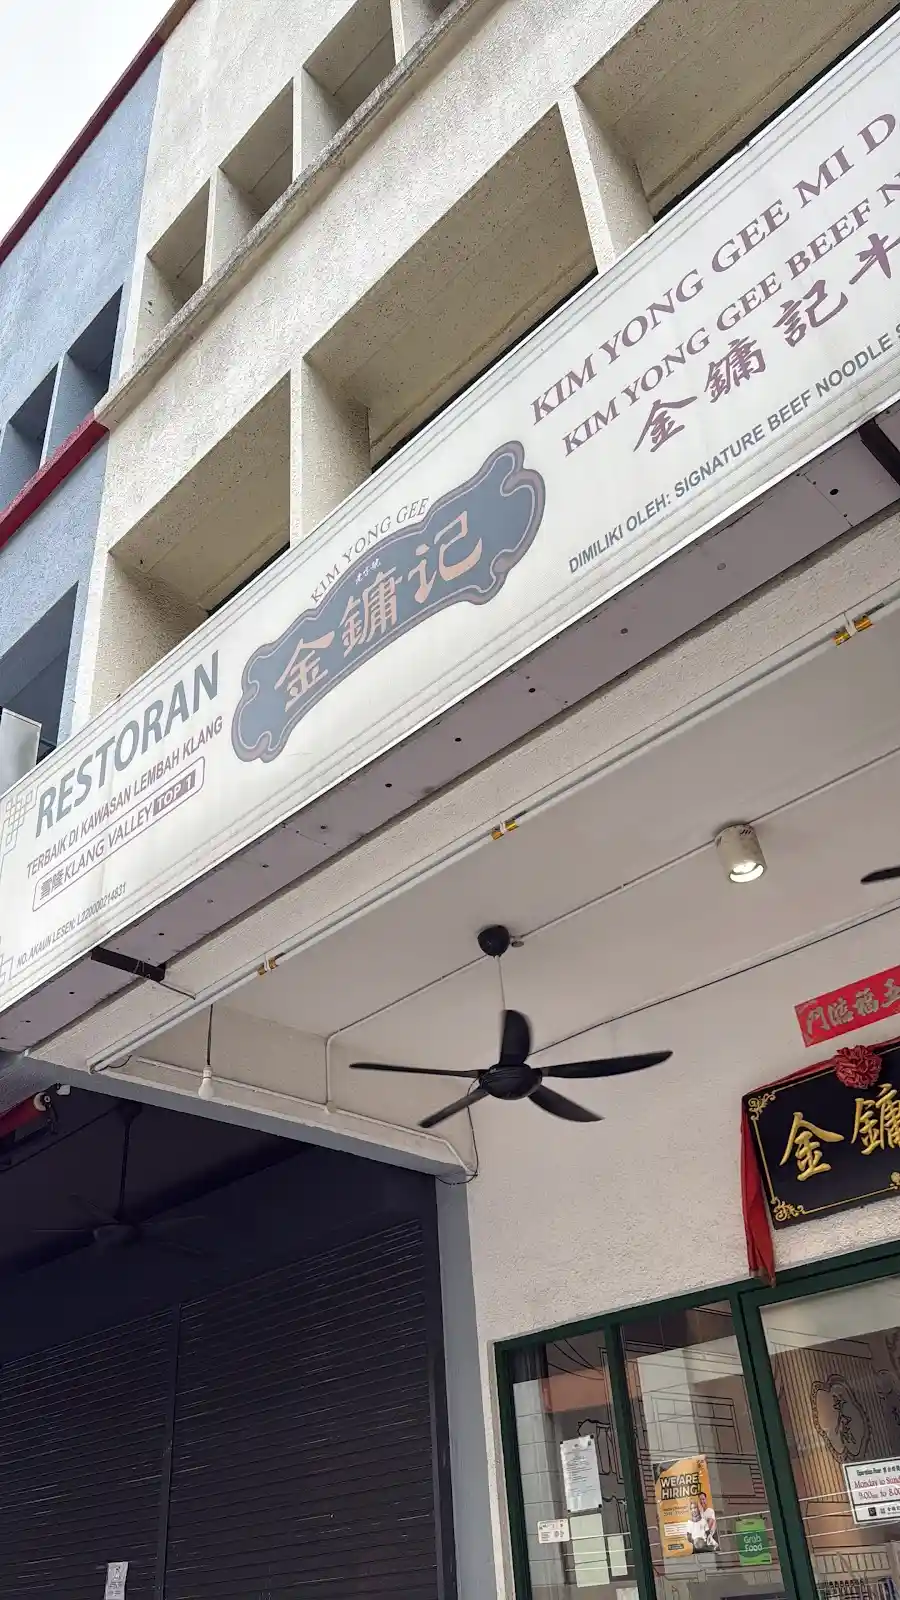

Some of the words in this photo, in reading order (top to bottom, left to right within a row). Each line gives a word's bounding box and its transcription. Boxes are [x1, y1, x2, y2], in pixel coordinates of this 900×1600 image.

[530, 354, 597, 425] KIM
[599, 268, 705, 364] YONG
[711, 199, 790, 273] GEE
[794, 145, 854, 208] MI
[561, 397, 620, 456] KIM
[621, 327, 710, 406] YONG
[716, 272, 782, 332] GEE
[785, 198, 871, 280] BEEF
[569, 527, 624, 574] DIMILIKI
[626, 495, 672, 533] OLEH:
[674, 424, 766, 498] SIGNATURE
[767, 390, 813, 432] BEEF
[815, 333, 893, 397] NOODLE
[311, 564, 341, 603] KIM
[342, 516, 391, 563] YONG
[397, 496, 429, 524] GEE
[27, 834, 67, 879] TERBAIK
[68, 825, 79, 848] DI
[80, 785, 131, 838] KAWASAN
[133, 748, 180, 797] LEMBAH
[183, 715, 223, 760] KLANG
[36, 650, 218, 838] RESTORAN
[64, 838, 105, 882] KLANG
[108, 802, 152, 848] VALLEY
[154, 784, 181, 815] TOP
[661, 1476, 677, 1488] WE
[677, 1472, 699, 1486] ARE
[662, 1483, 701, 1499] HIRING!
[744, 1533, 762, 1544] Grab
[745, 1543, 763, 1553] Food
